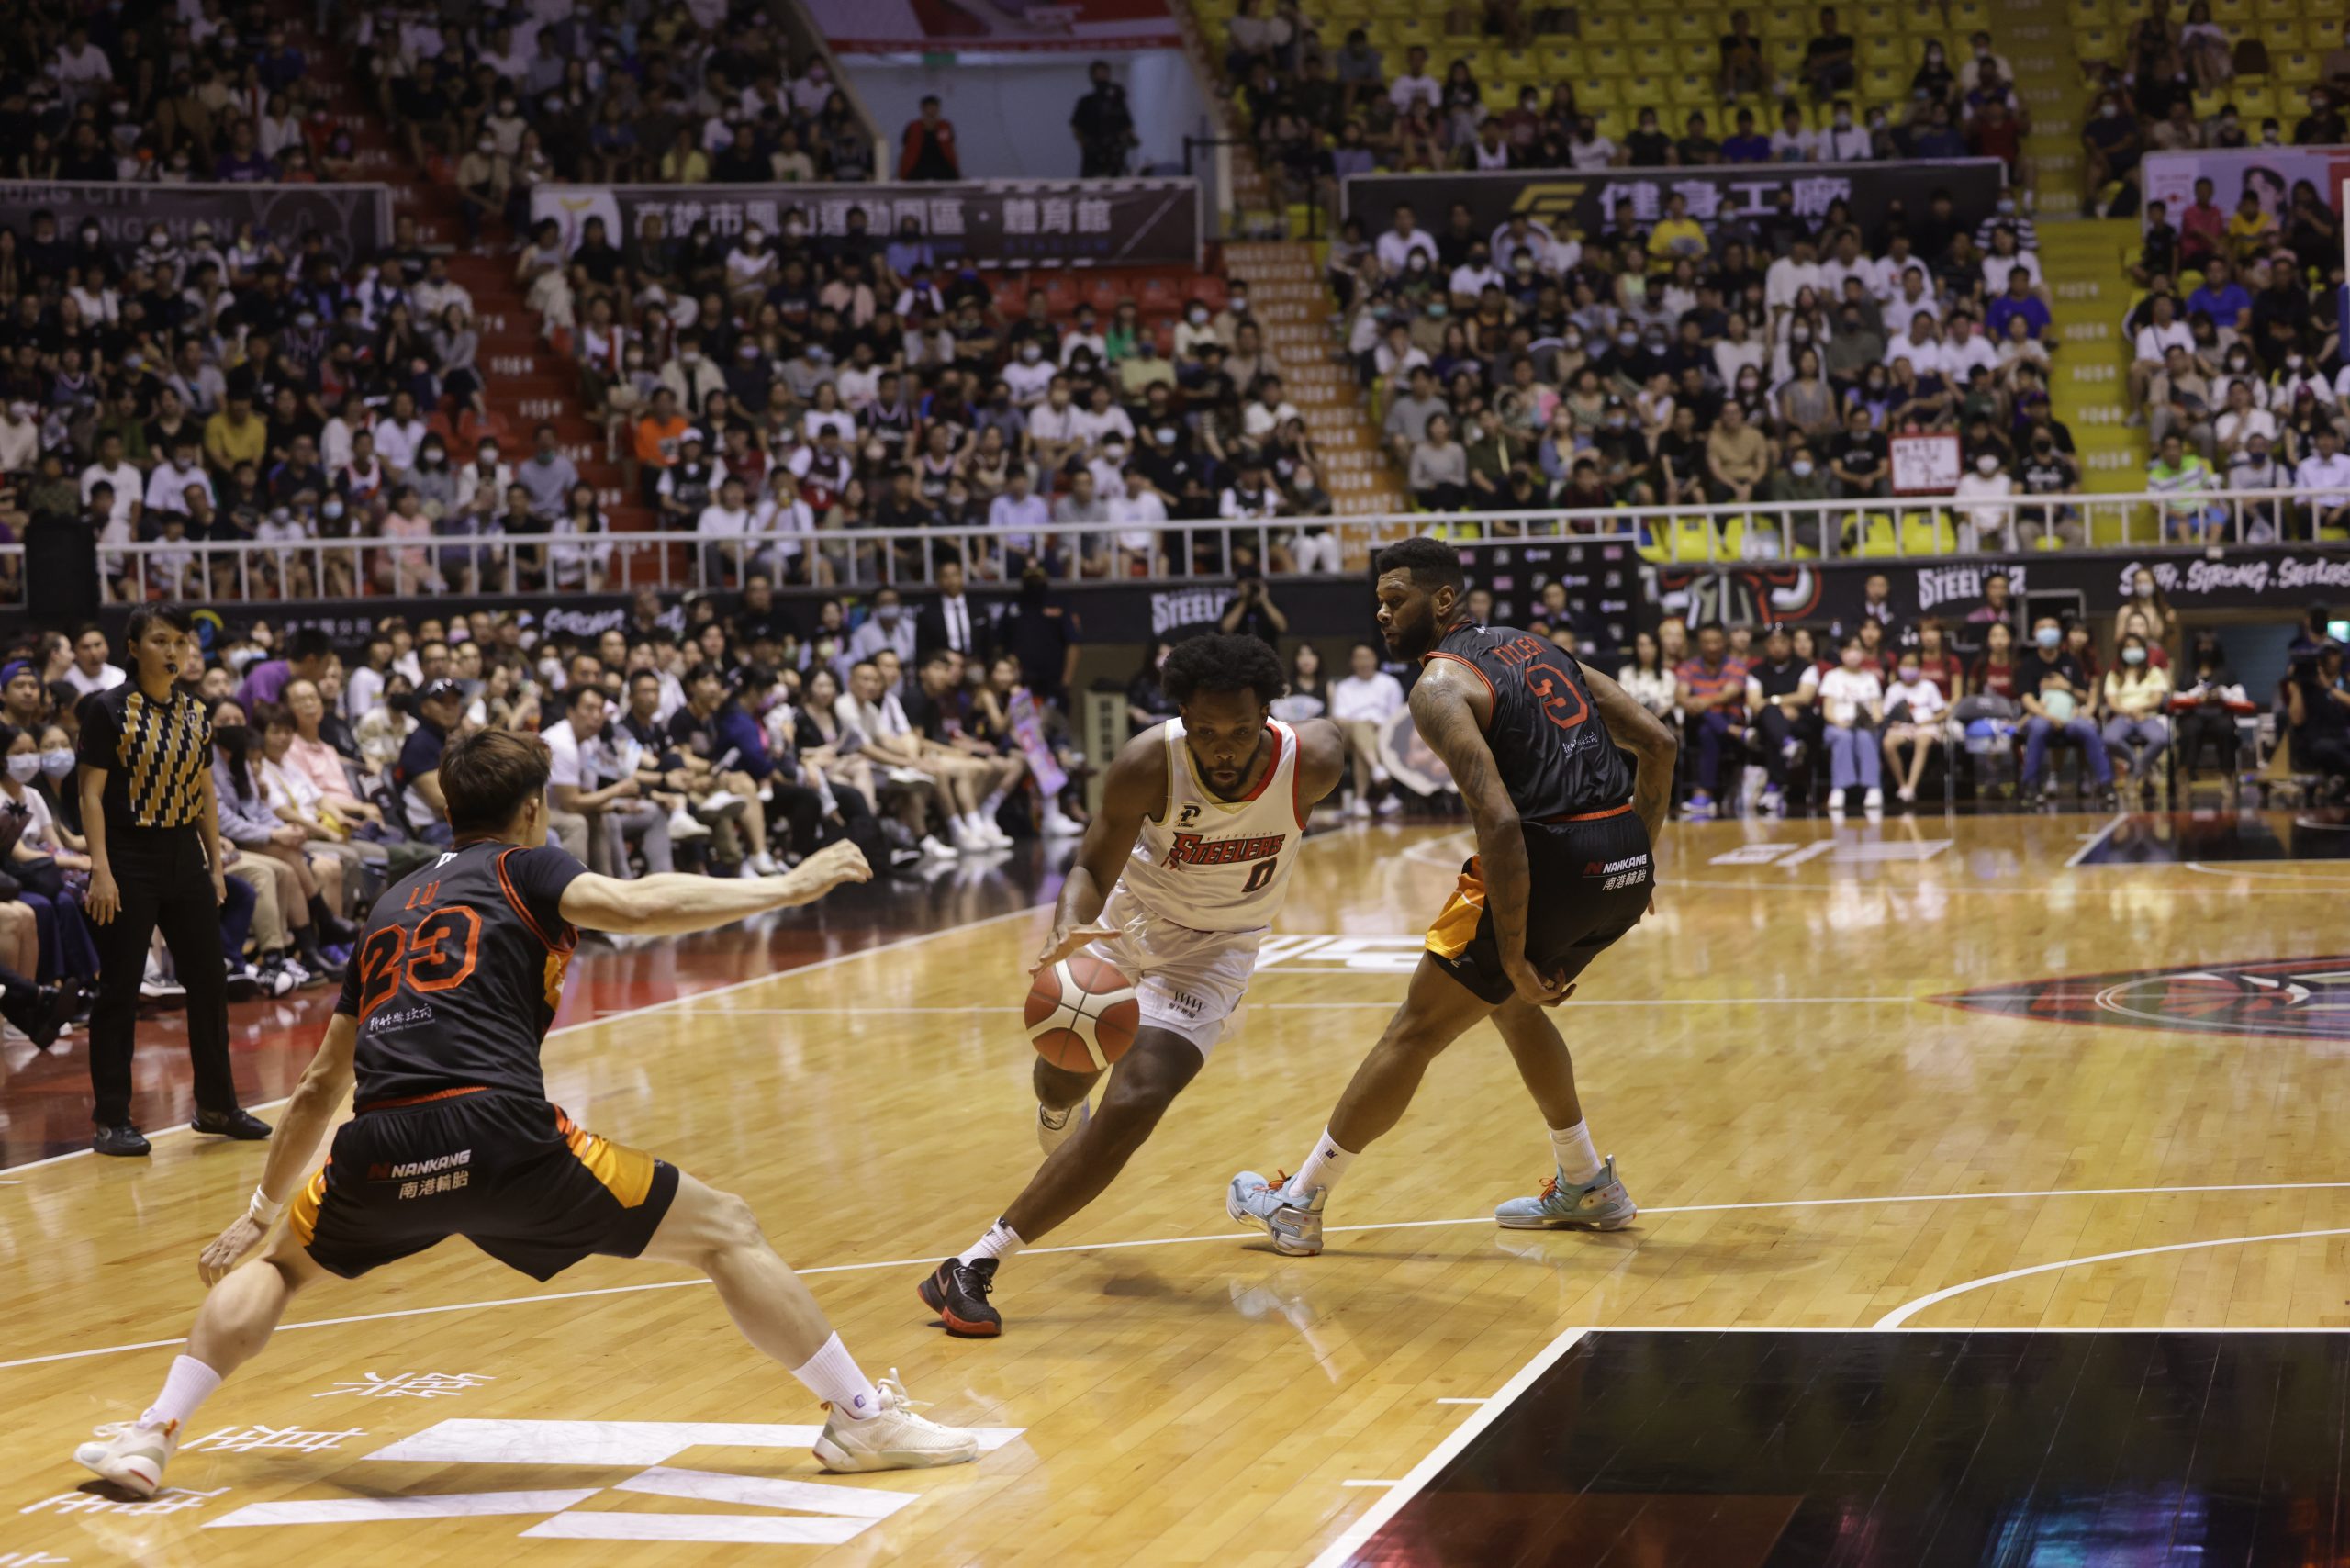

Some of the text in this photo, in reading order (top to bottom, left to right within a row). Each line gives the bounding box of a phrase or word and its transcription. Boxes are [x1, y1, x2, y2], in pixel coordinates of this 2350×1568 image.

[1492, 635, 1547, 667] TYLER
[1525, 663, 1588, 730] 3
[1169, 832, 1286, 865] STEELERS
[1241, 857, 1278, 893] 0
[1602, 868, 1647, 890] 南港輪胎
[405, 879, 440, 910] LU
[359, 905, 483, 1025] 23
[398, 1170, 469, 1199] 南港輪胎
